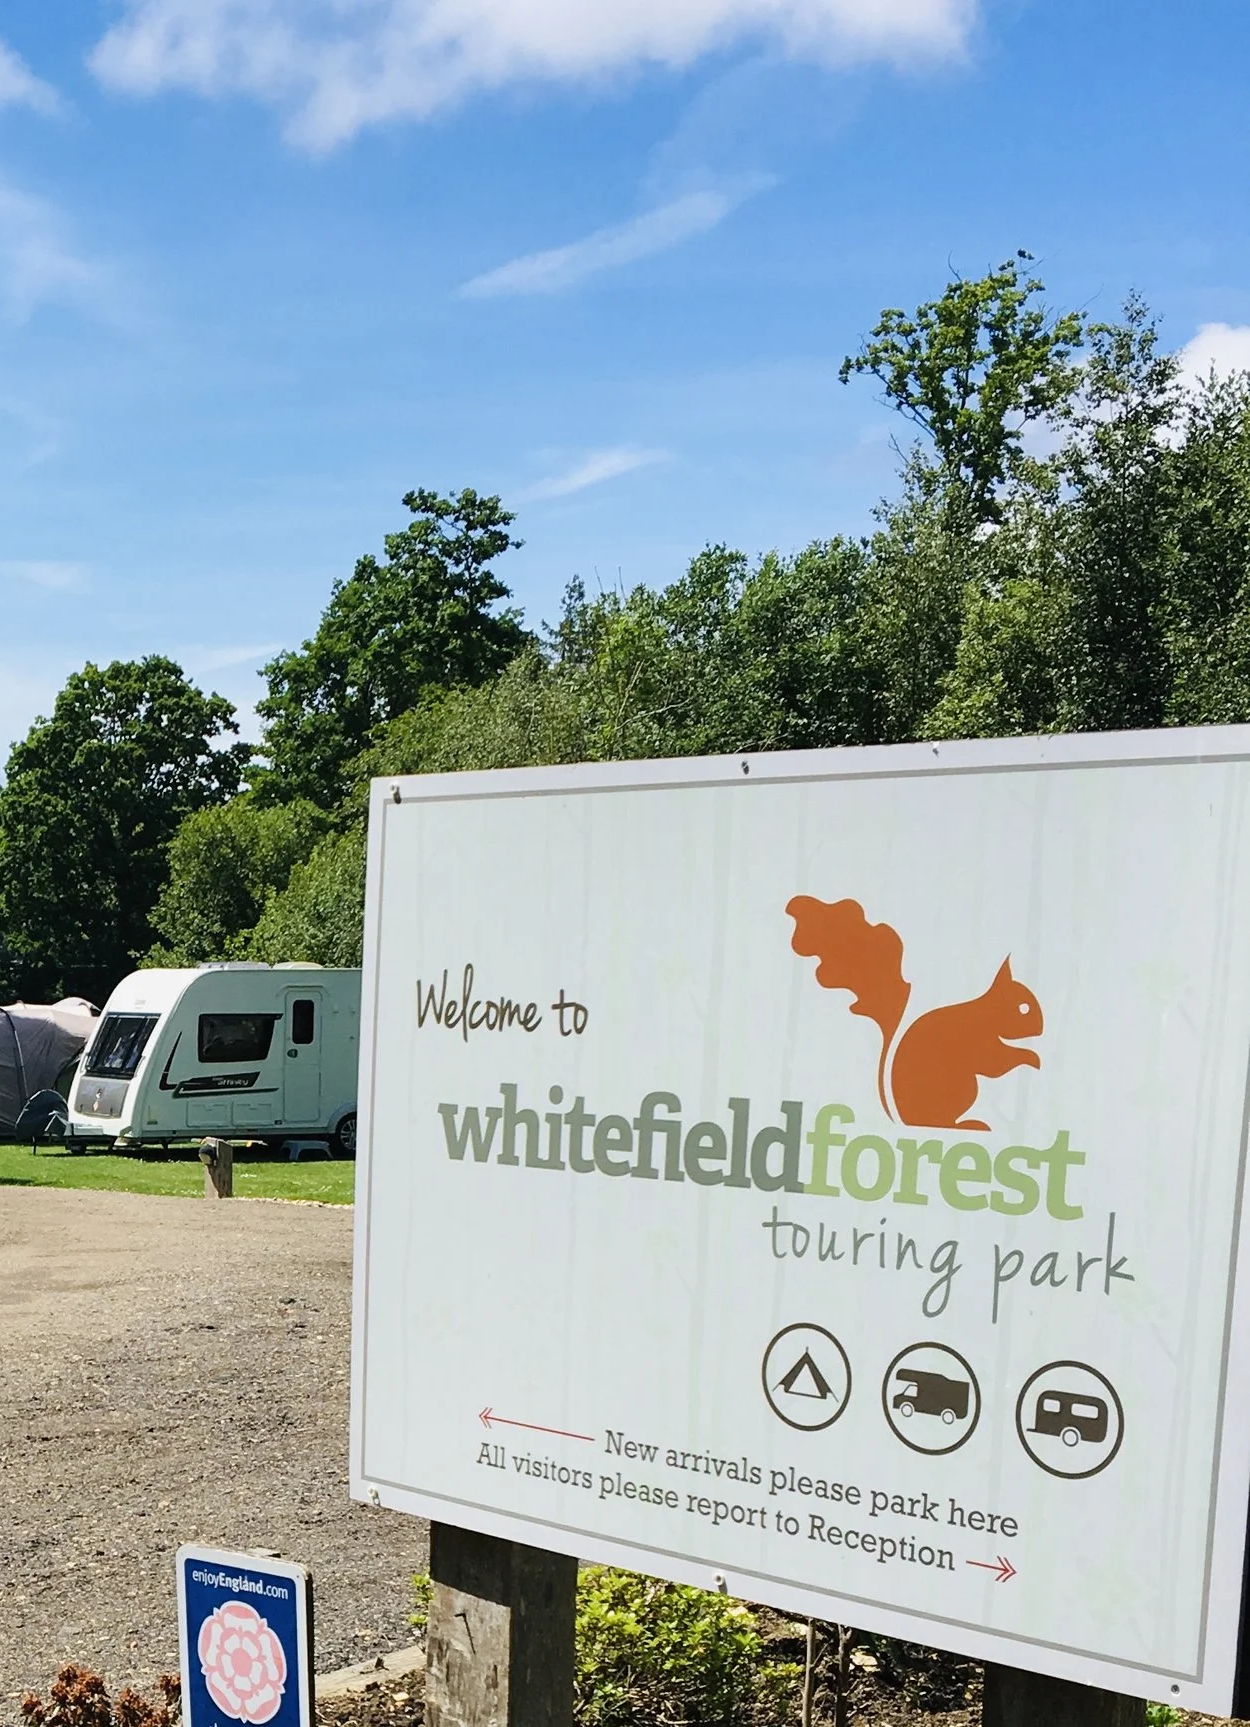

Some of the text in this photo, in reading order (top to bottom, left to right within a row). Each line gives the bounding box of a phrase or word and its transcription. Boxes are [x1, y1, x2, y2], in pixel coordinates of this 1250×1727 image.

[416, 963, 589, 1042] Welcome to
[762, 1206, 1136, 1323] touring park
[477, 1442, 955, 1570] All visitors please report to Reception
[605, 1430, 1019, 1536] New arrivals please park here
[192, 1569, 289, 1600] enjoyEngland.com
